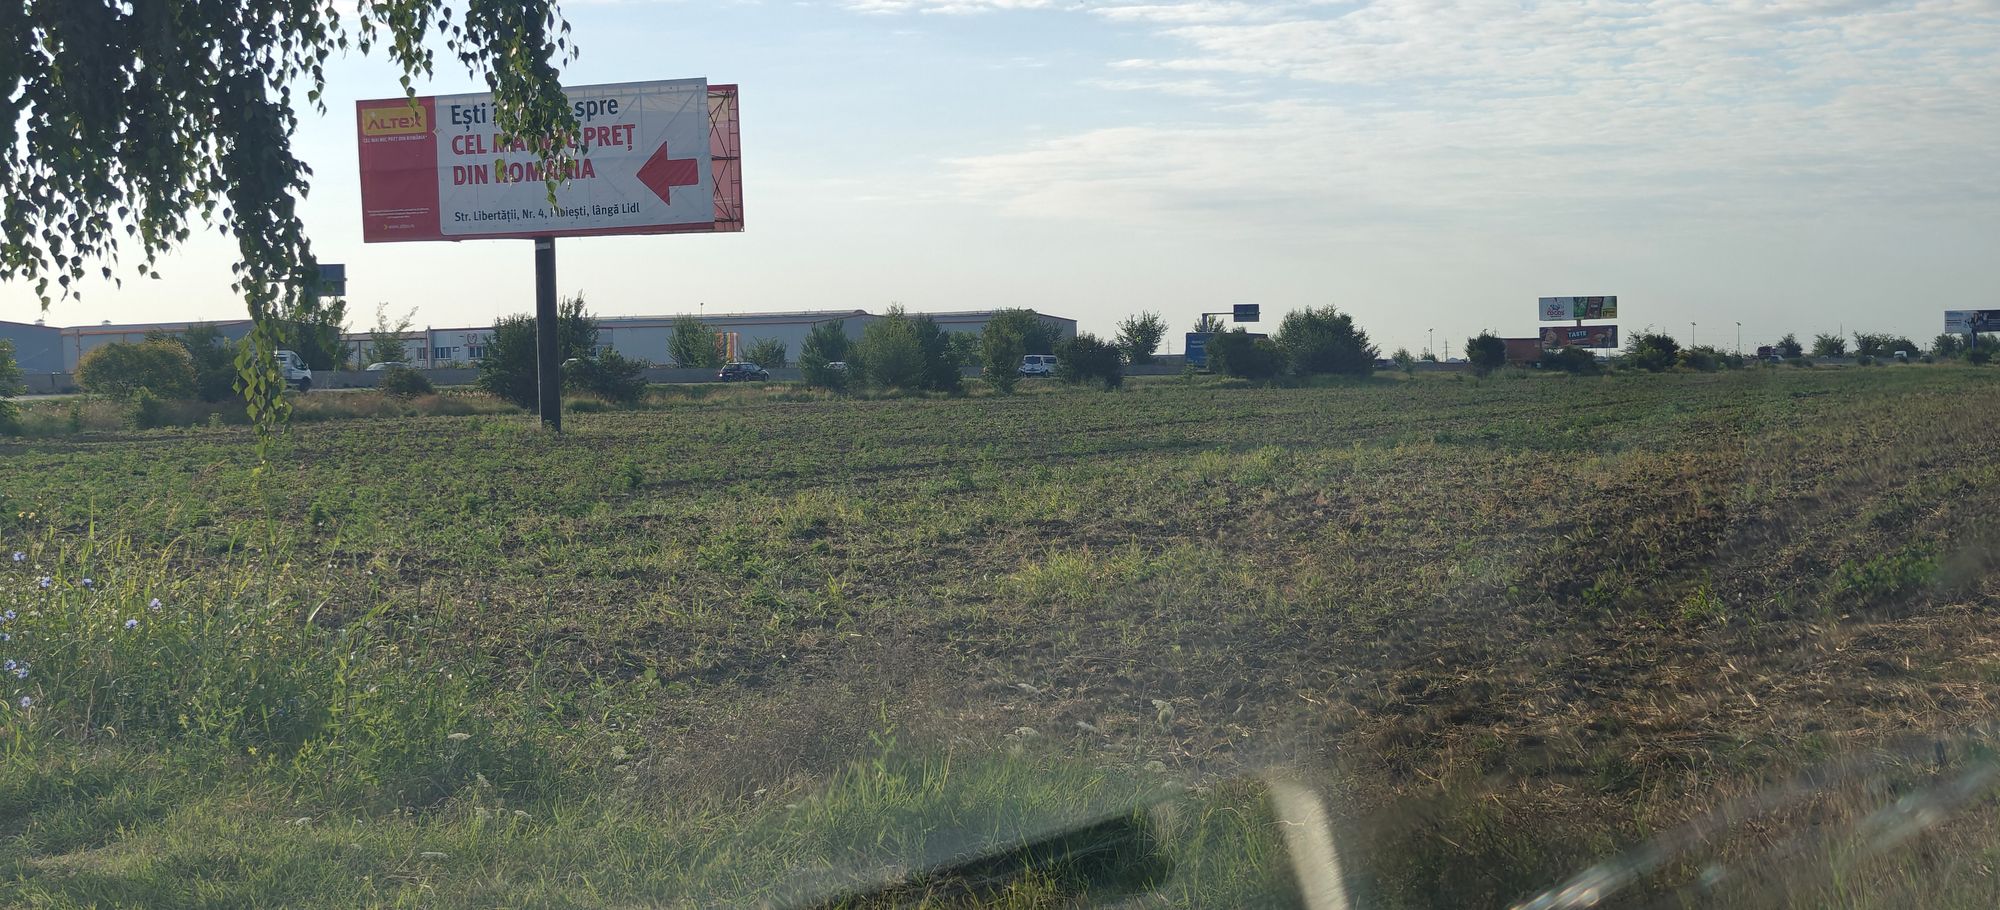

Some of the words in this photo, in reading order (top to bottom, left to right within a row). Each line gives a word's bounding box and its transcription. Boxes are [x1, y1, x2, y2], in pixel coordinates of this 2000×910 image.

[451, 103, 487, 131] Ești
[574, 99, 618, 122] spre
[452, 133, 487, 155] CEL
[492, 130, 532, 153] MA
[583, 123, 636, 151] PREȚ
[453, 164, 488, 185] DIN
[454, 211, 471, 222] Str.
[473, 209, 520, 222] Libertății,
[522, 208, 536, 219] Nr.
[538, 208, 548, 219] 4,
[592, 204, 619, 216] lângă
[621, 202, 640, 214] Lidl
